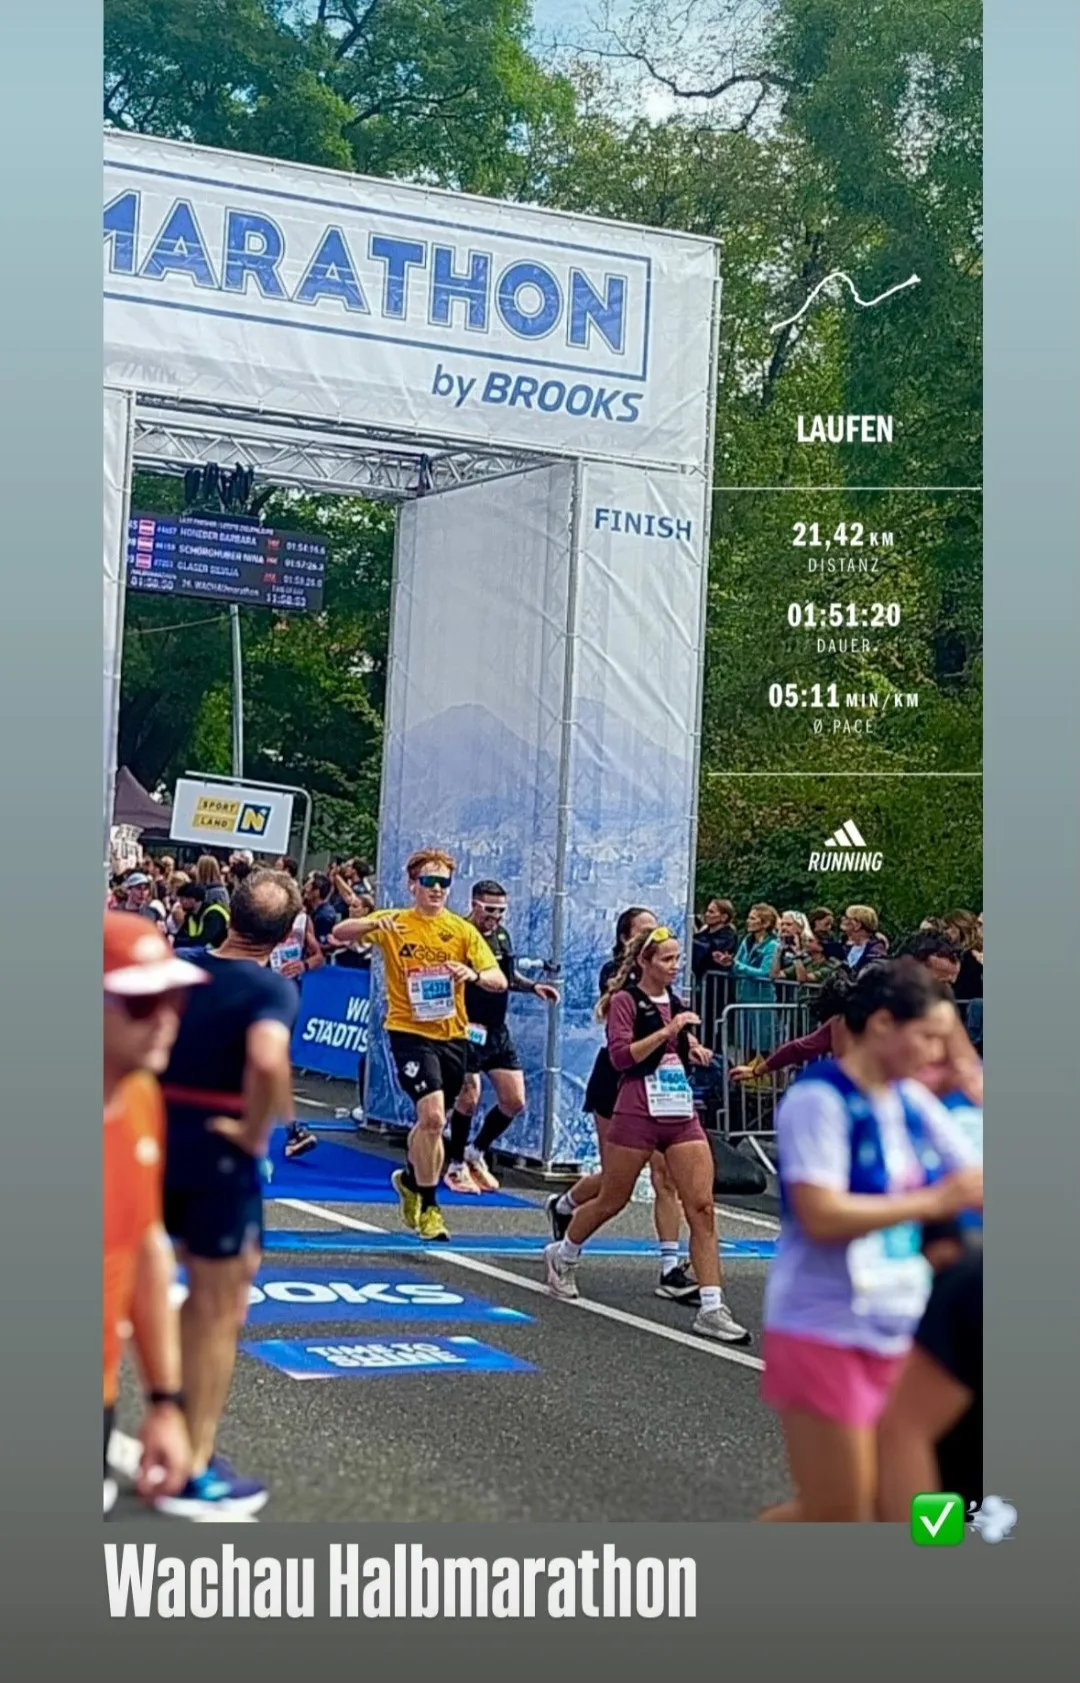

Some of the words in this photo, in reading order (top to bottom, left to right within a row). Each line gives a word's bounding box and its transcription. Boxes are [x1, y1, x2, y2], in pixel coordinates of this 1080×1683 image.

[431, 364, 477, 408] by
[481, 371, 644, 423] BROOKS
[594, 508, 692, 541] FINISH
[202, 800, 236, 814] SPORT
[200, 816, 228, 828] LAND
[346, 997, 371, 1019] WI
[306, 1343, 394, 1357] TIME
[390, 1342, 440, 1352] TO
